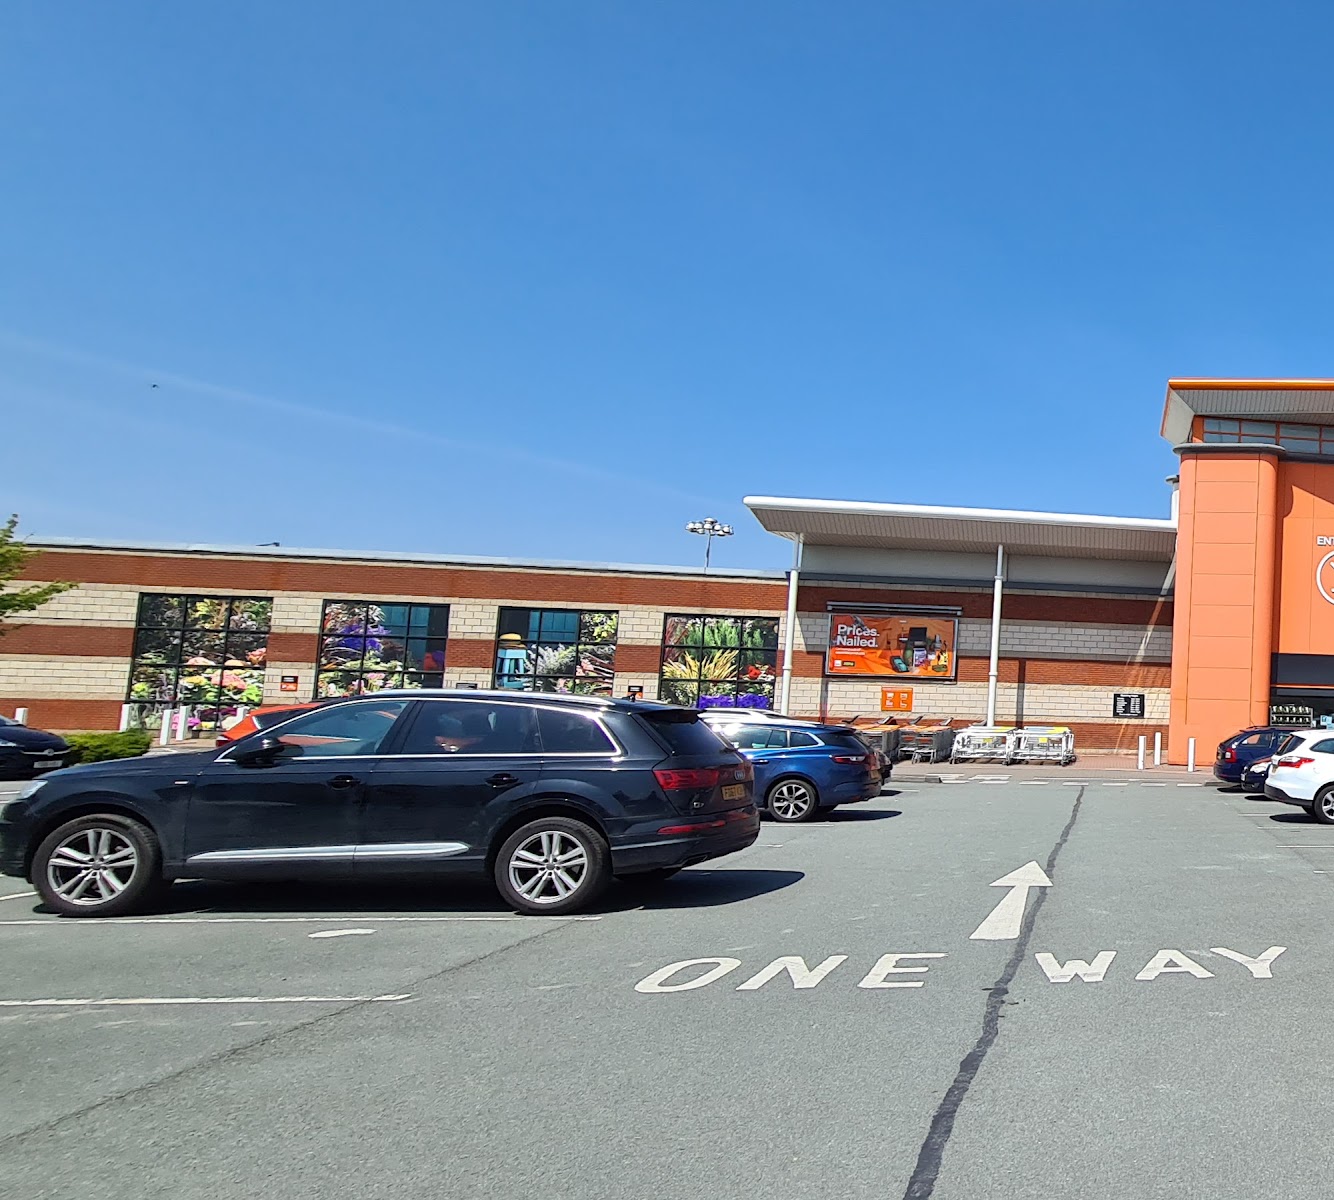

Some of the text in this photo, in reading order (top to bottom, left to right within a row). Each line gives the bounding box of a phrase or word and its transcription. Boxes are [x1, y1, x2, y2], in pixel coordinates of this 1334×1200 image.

[837, 624, 880, 636] Prices.
[837, 635, 879, 648] Nailed.
[634, 945, 1288, 994] ONE WAY
